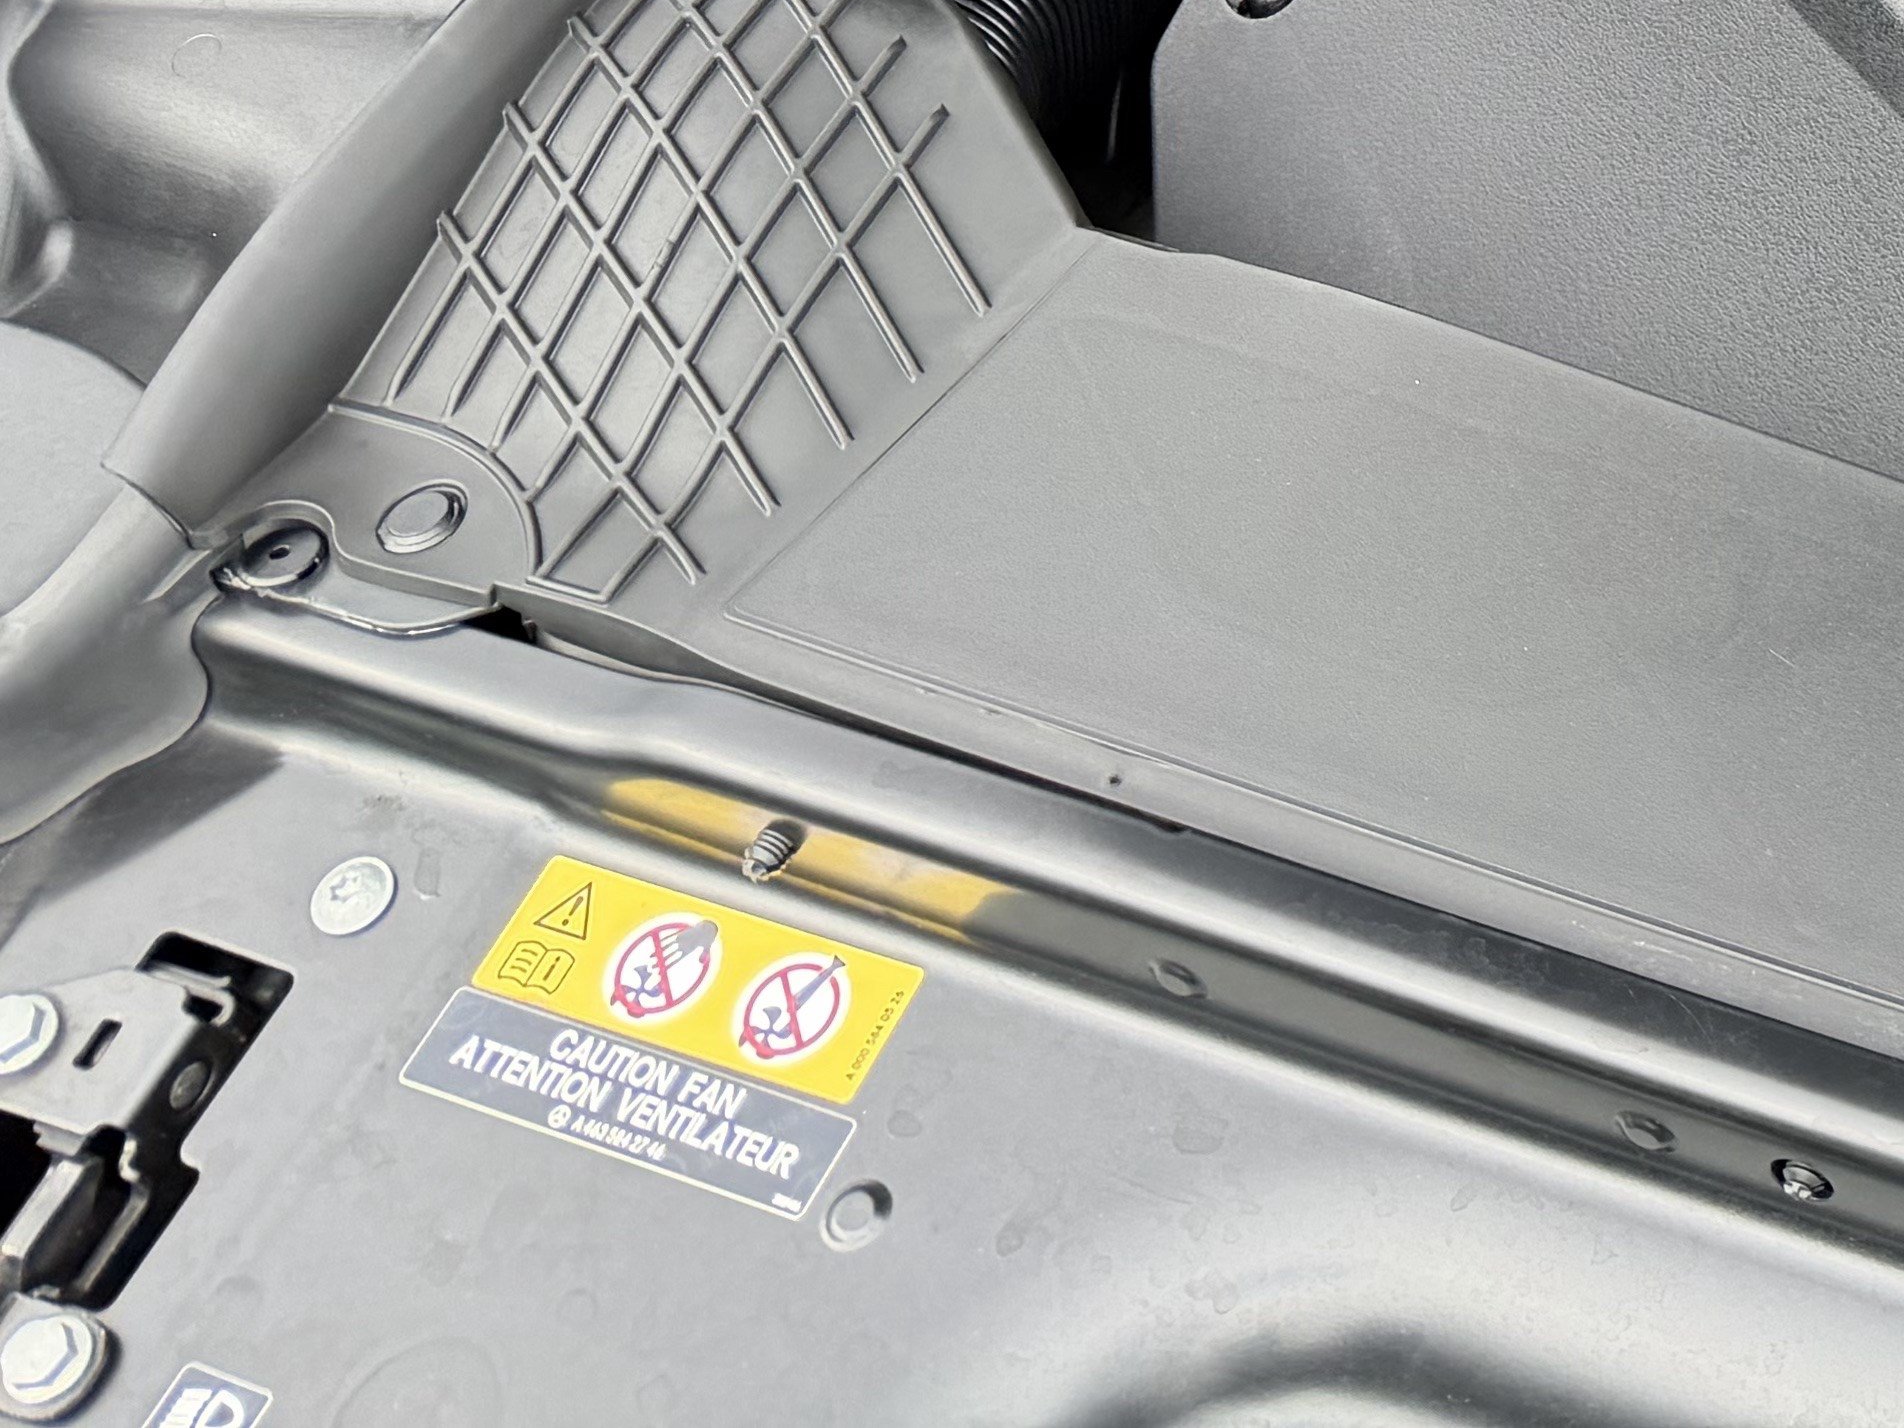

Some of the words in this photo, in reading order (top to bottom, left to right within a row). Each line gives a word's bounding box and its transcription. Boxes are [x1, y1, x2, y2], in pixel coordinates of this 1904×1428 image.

[448, 1034, 615, 1115] ATTENTION
[615, 1087, 800, 1181] VENTILATEUR
[548, 1028, 679, 1096] CAUTION
[678, 1074, 748, 1121] FAN
